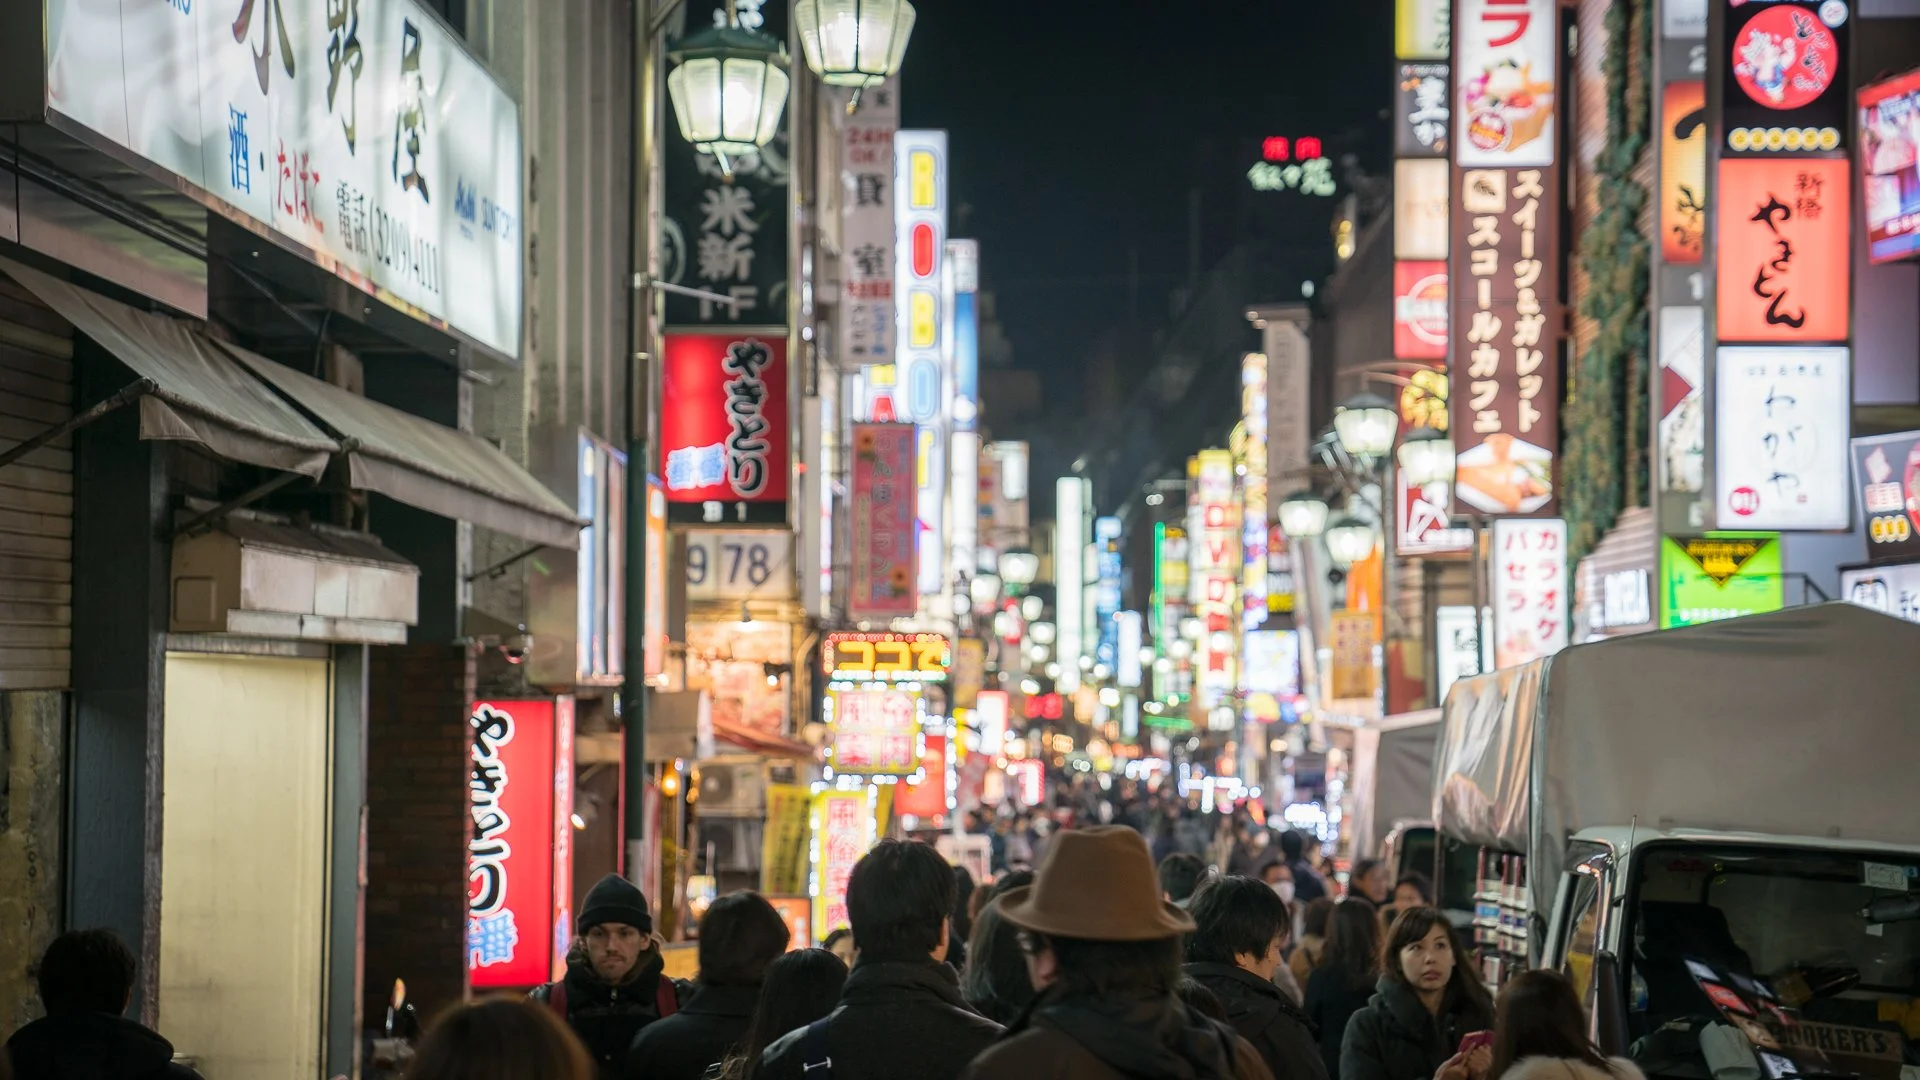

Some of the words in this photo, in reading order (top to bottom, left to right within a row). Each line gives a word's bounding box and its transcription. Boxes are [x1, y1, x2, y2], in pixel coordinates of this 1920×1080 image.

[724, 337, 772, 496] やきとり
[1536, 530, 1558, 641] カラオケ
